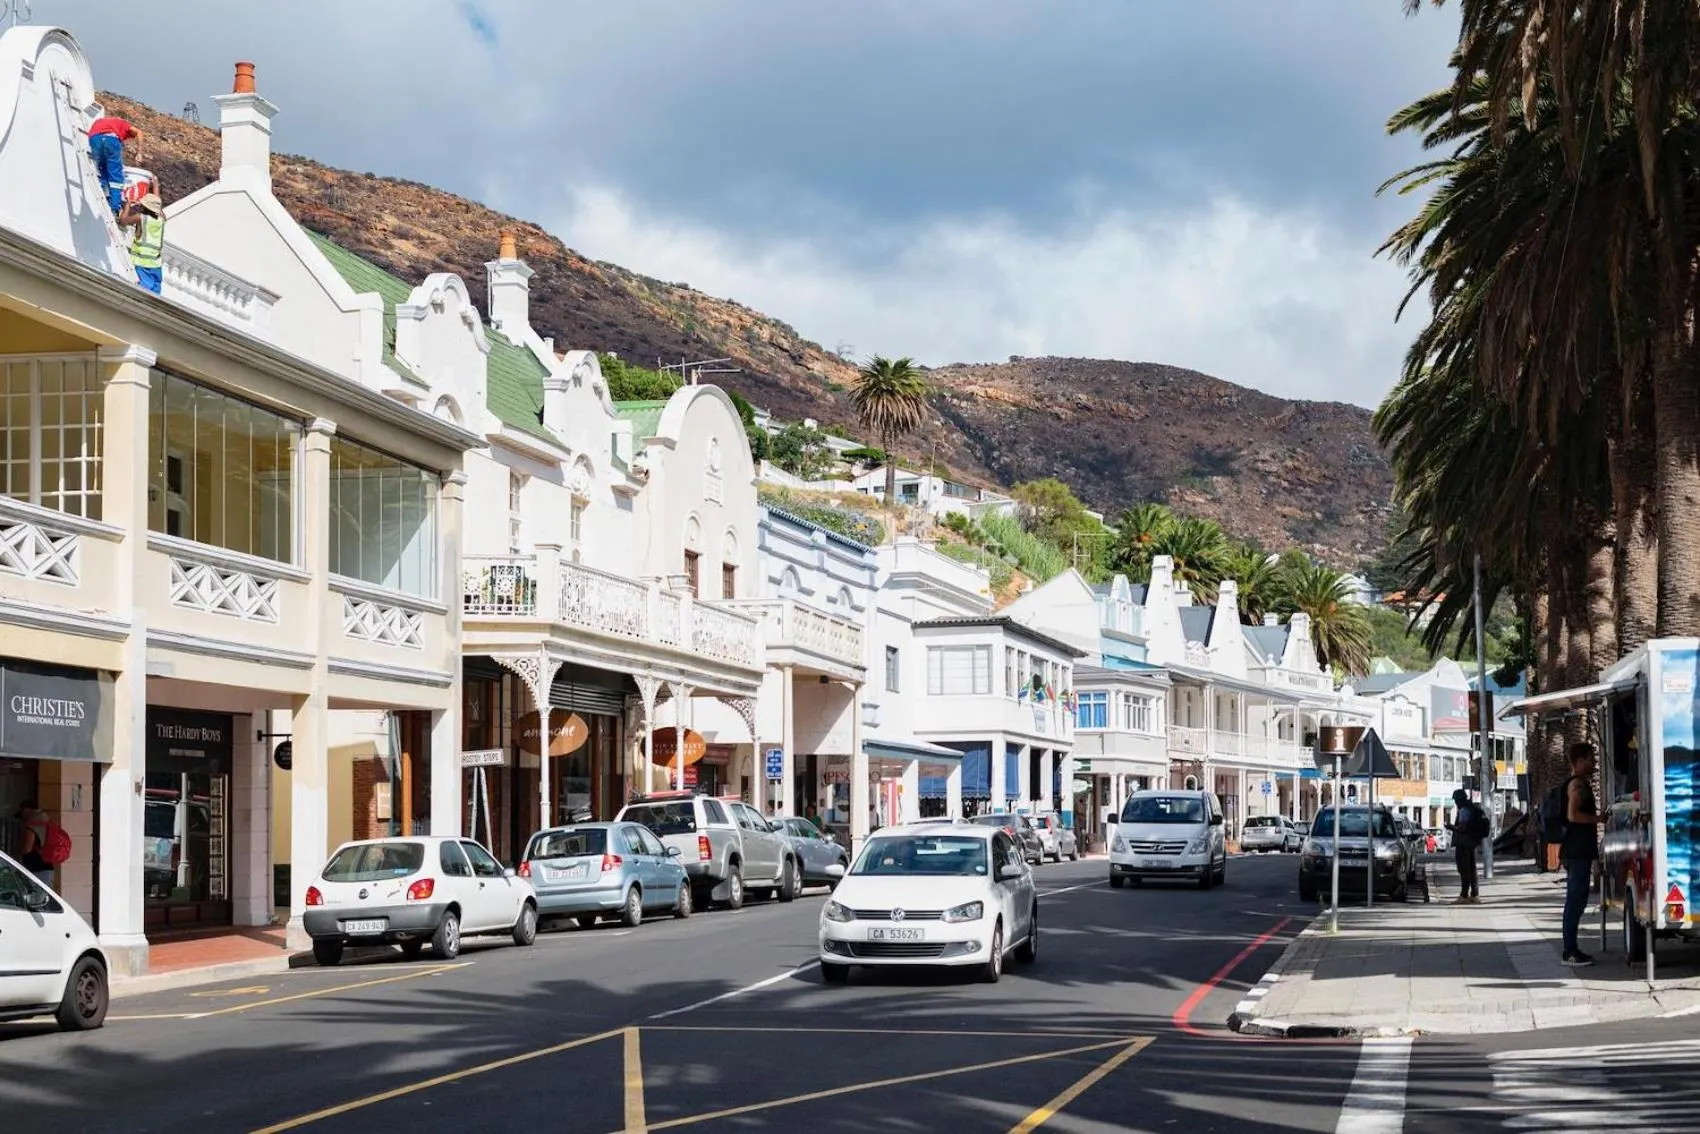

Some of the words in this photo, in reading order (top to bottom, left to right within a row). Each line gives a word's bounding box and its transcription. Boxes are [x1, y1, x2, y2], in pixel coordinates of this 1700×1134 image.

[11, 695, 85, 719] CHRISTIE'S
[156, 724, 173, 738] THE
[175, 725, 201, 740] HARDY
[202, 727, 221, 742] BOYS
[873, 929, 884, 939] CA
